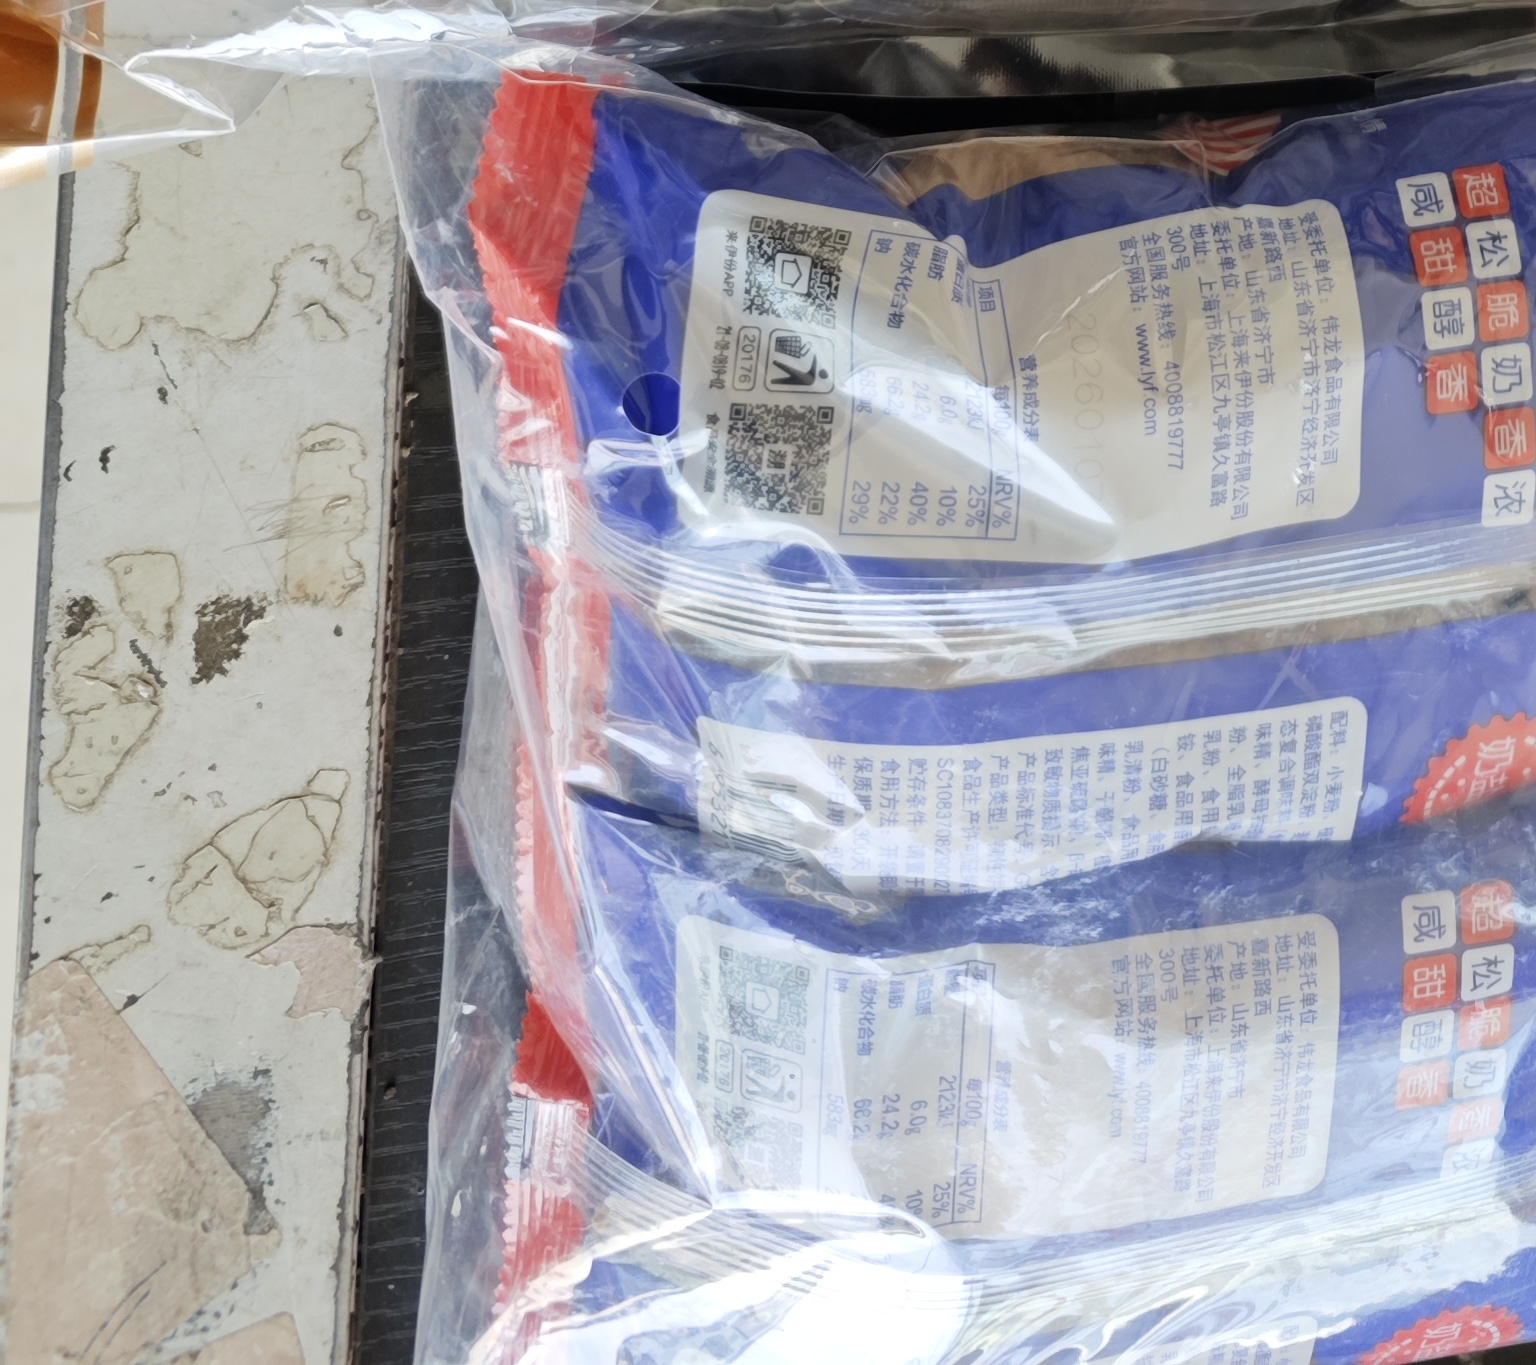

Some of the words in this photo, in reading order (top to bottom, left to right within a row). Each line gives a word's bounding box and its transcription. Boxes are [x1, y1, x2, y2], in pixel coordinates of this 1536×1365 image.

[874, 237, 892, 254] 钠
[927, 245, 948, 281] 脂肪
[1166, 226, 1191, 272] 300号
[1256, 215, 1288, 282] 嘉新路西
[887, 241, 921, 329] 碳水化合物
[1406, 180, 1475, 410] 咸甜醇香
[737, 334, 755, 384] 20176
[978, 285, 996, 312] 项目
[991, 469, 1014, 529] NRV%
[1019, 354, 1040, 443] 营养成分表
[849, 480, 871, 524] 29%
[879, 481, 900, 525] 22%
[907, 481, 928, 526] 40%
[936, 486, 956, 527] 10%
[964, 485, 986, 528] 25%
[1157, 949, 1179, 1004] 300号
[1251, 937, 1273, 1017] 嘉新路西
